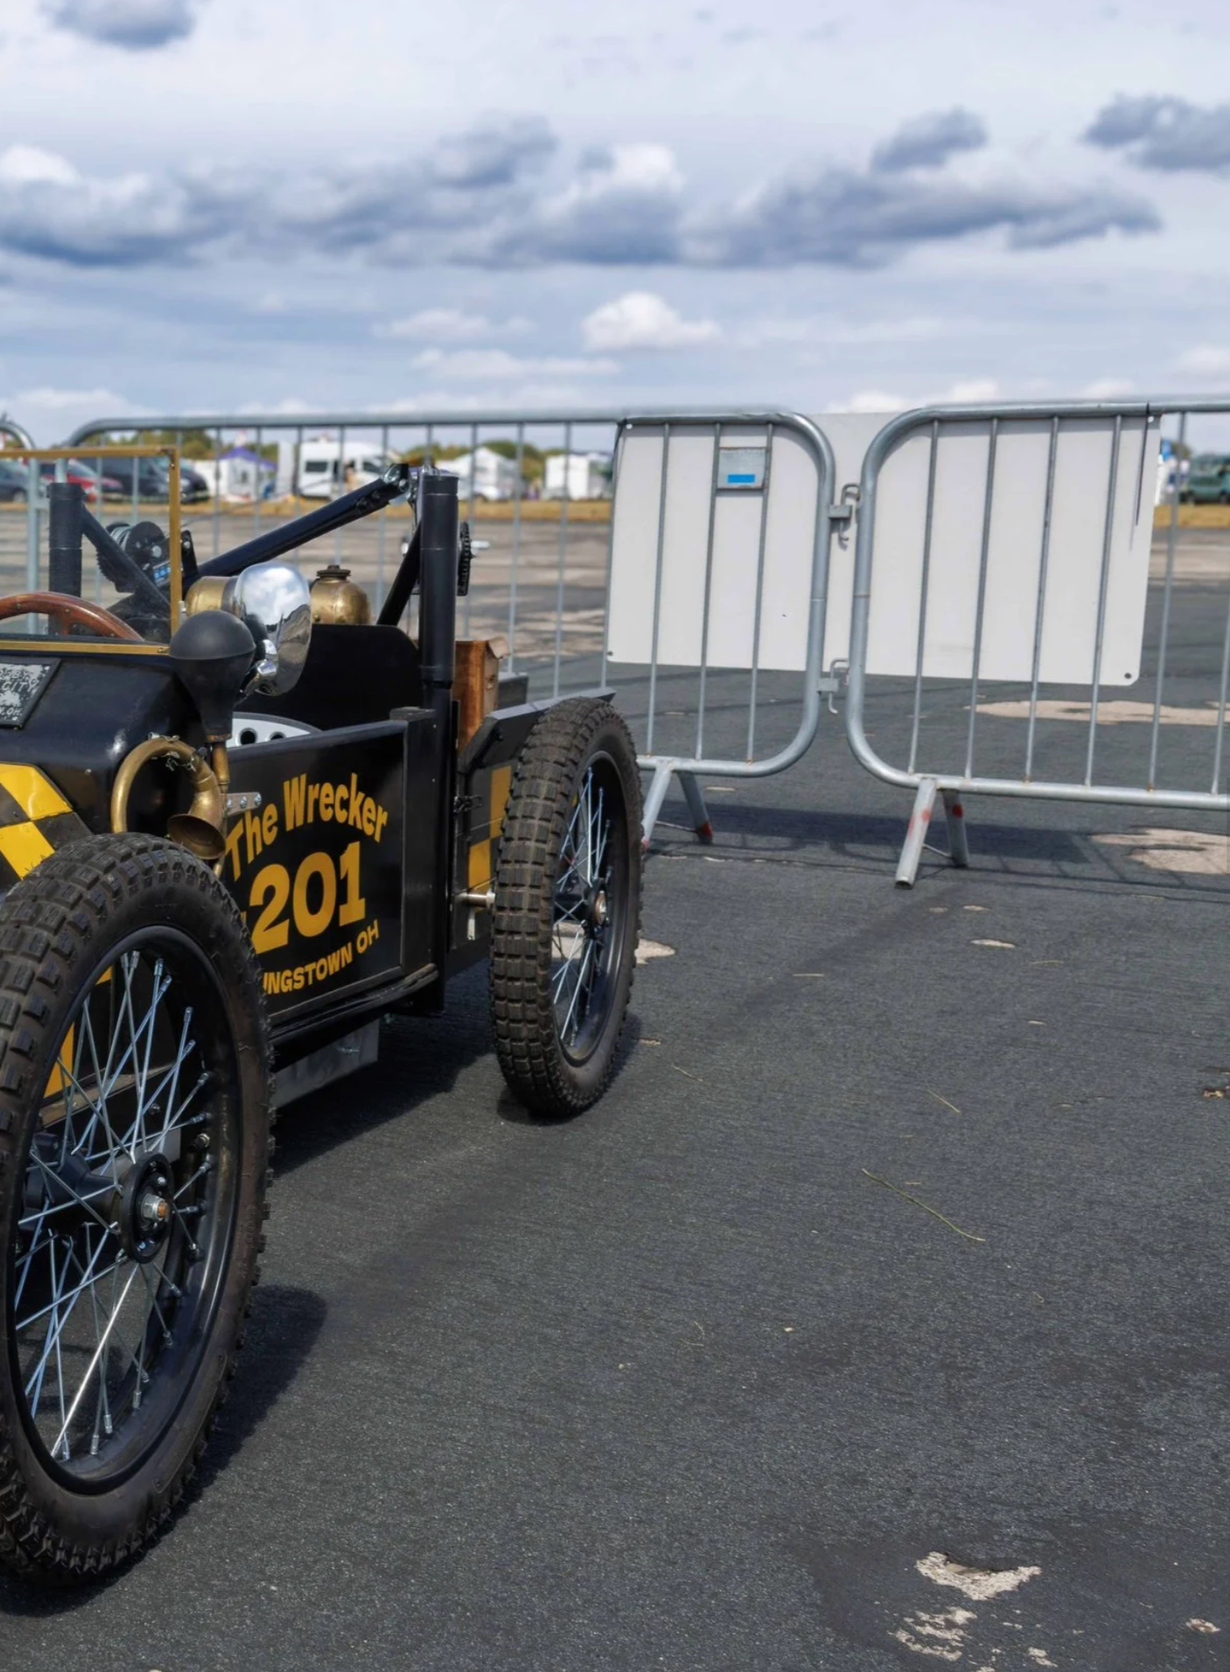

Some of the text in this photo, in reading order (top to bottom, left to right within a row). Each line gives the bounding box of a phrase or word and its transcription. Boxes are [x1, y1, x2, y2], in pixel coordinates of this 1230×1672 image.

[1, 680, 38, 693] CITY
[225, 772, 388, 882] The Wrecker
[249, 841, 365, 954] 201
[356, 919, 379, 954] OH
